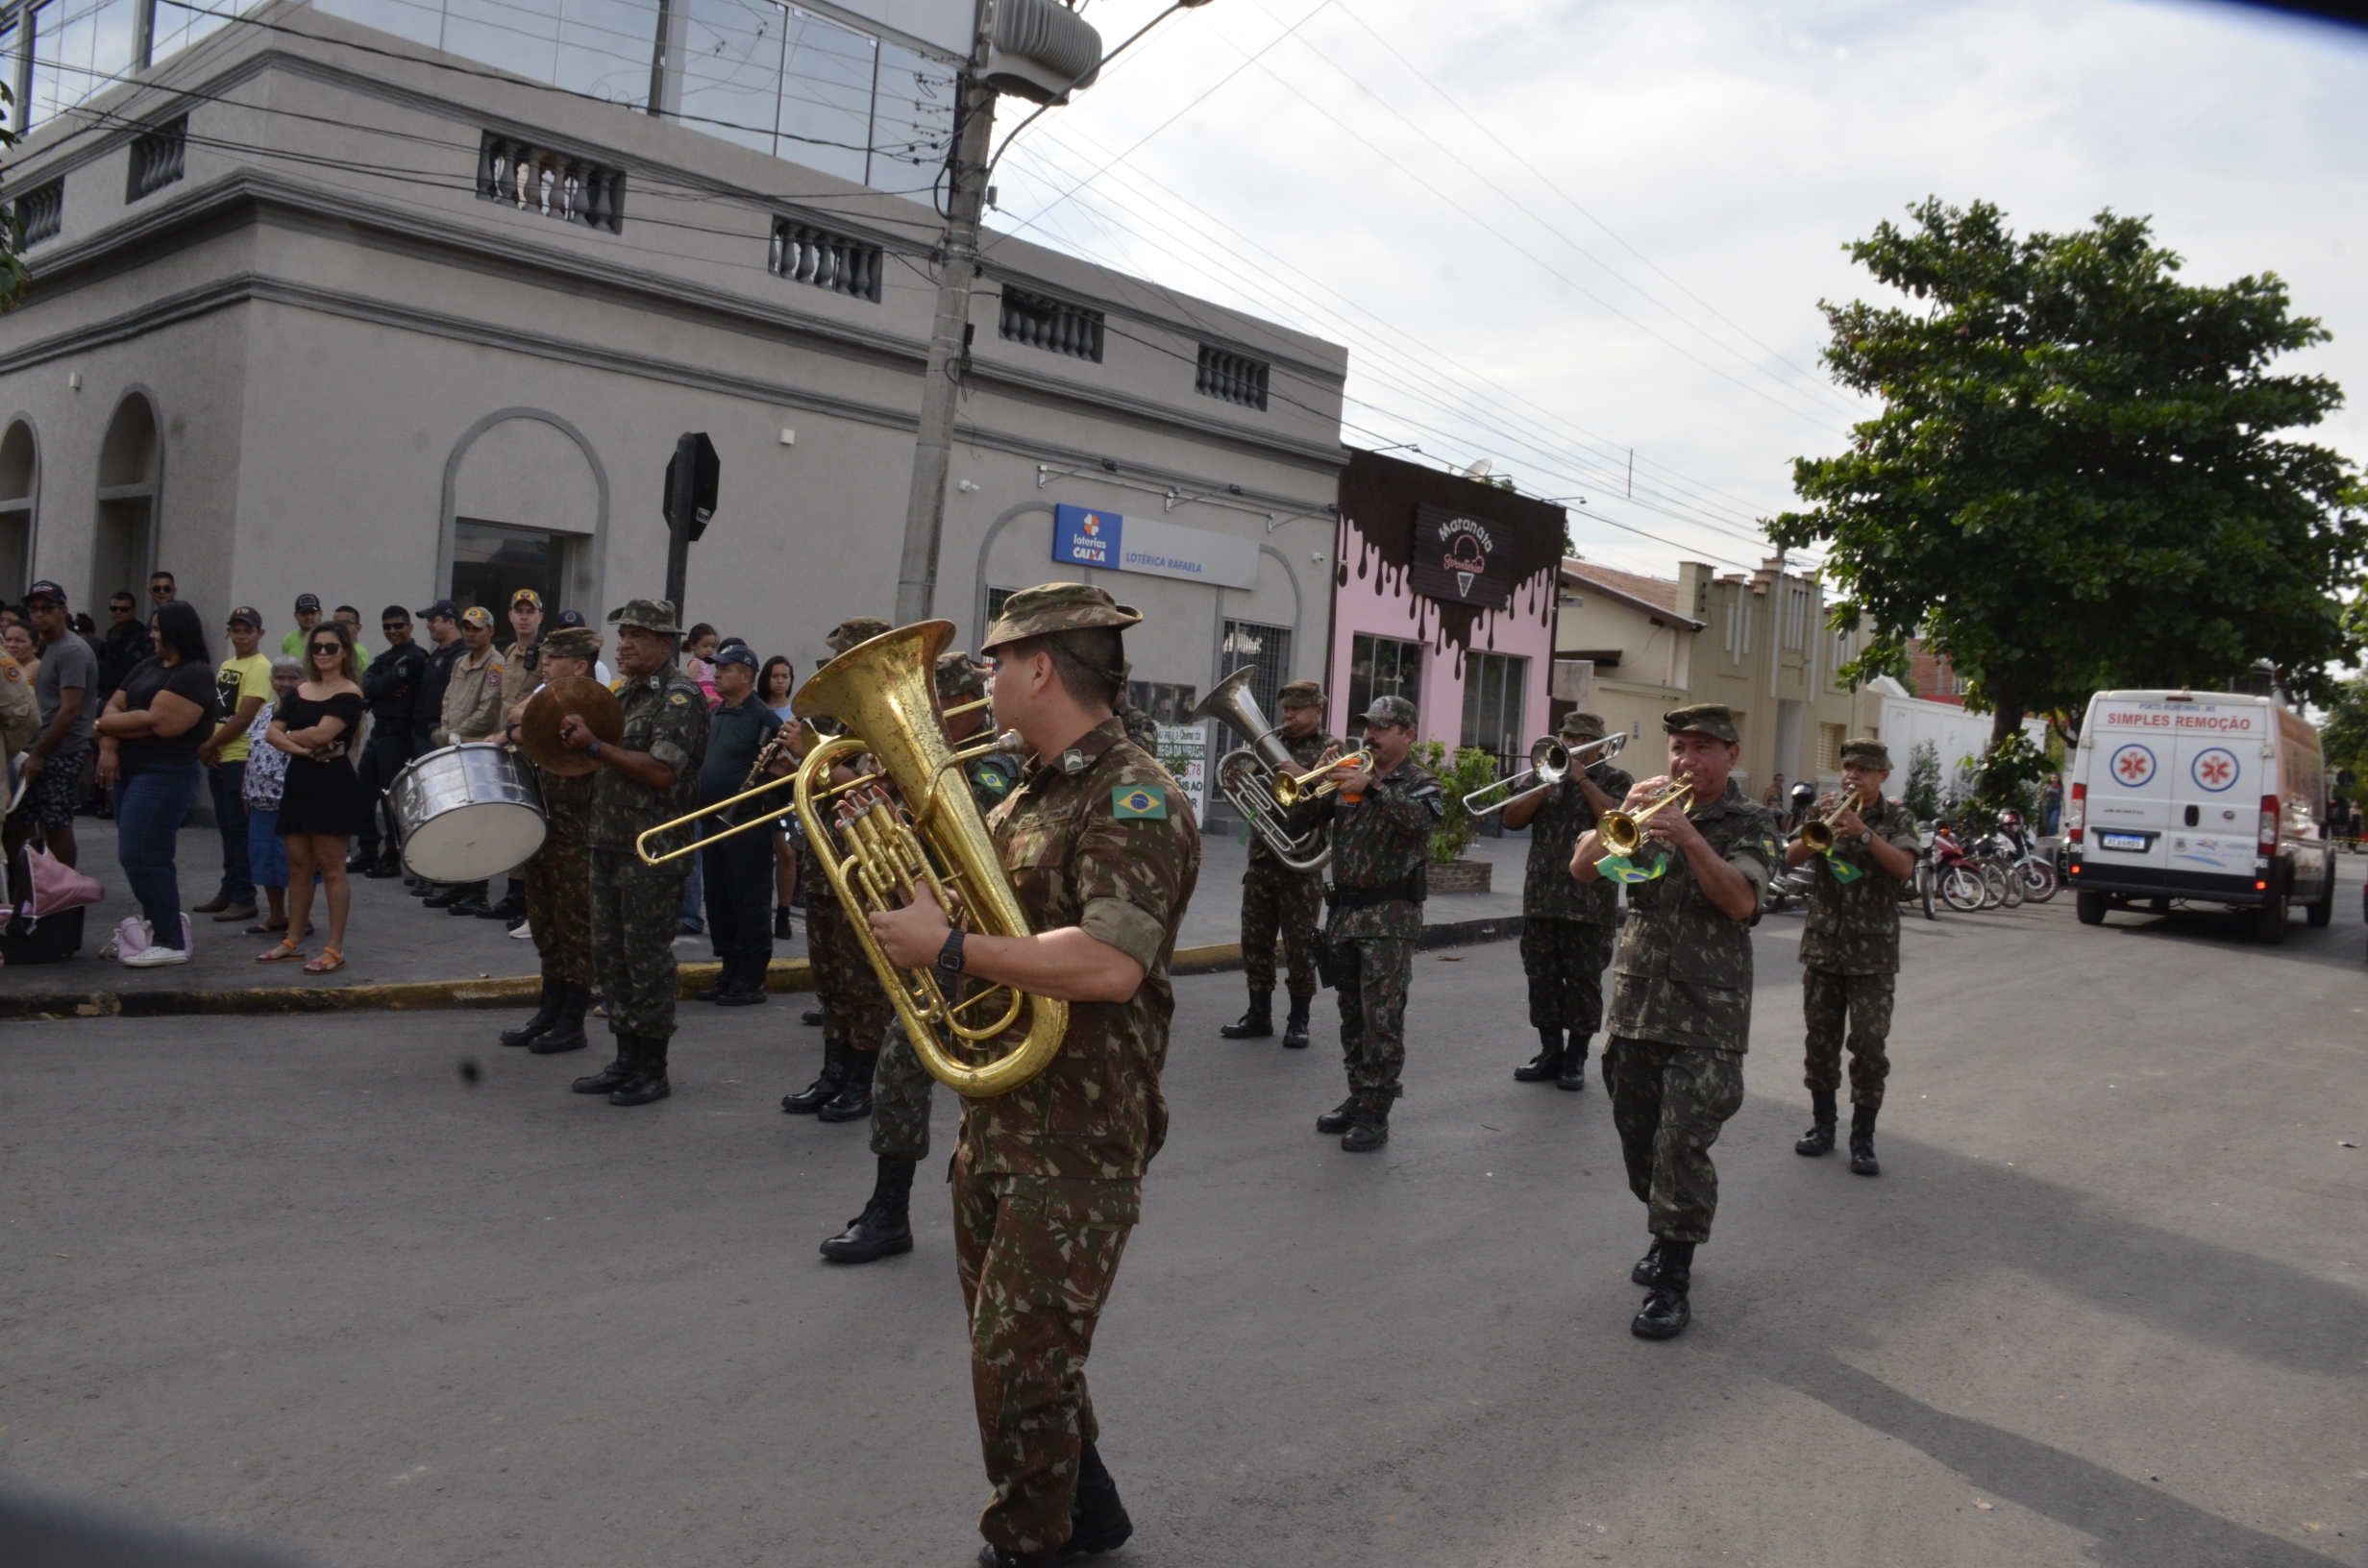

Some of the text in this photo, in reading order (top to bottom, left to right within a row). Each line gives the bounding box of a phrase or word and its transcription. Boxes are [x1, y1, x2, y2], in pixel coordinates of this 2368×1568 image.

[1073, 534, 1106, 550] loterias
[1439, 518, 1492, 552] Maranata
[1073, 547, 1105, 562] CAIXA
[1125, 551, 1202, 574] LOTÉRICA RAFAELA
[2108, 713, 2251, 732] SIMPLES REMOÇÃO
[1195, 730, 1201, 741] da
[1191, 781, 1203, 792] AO
